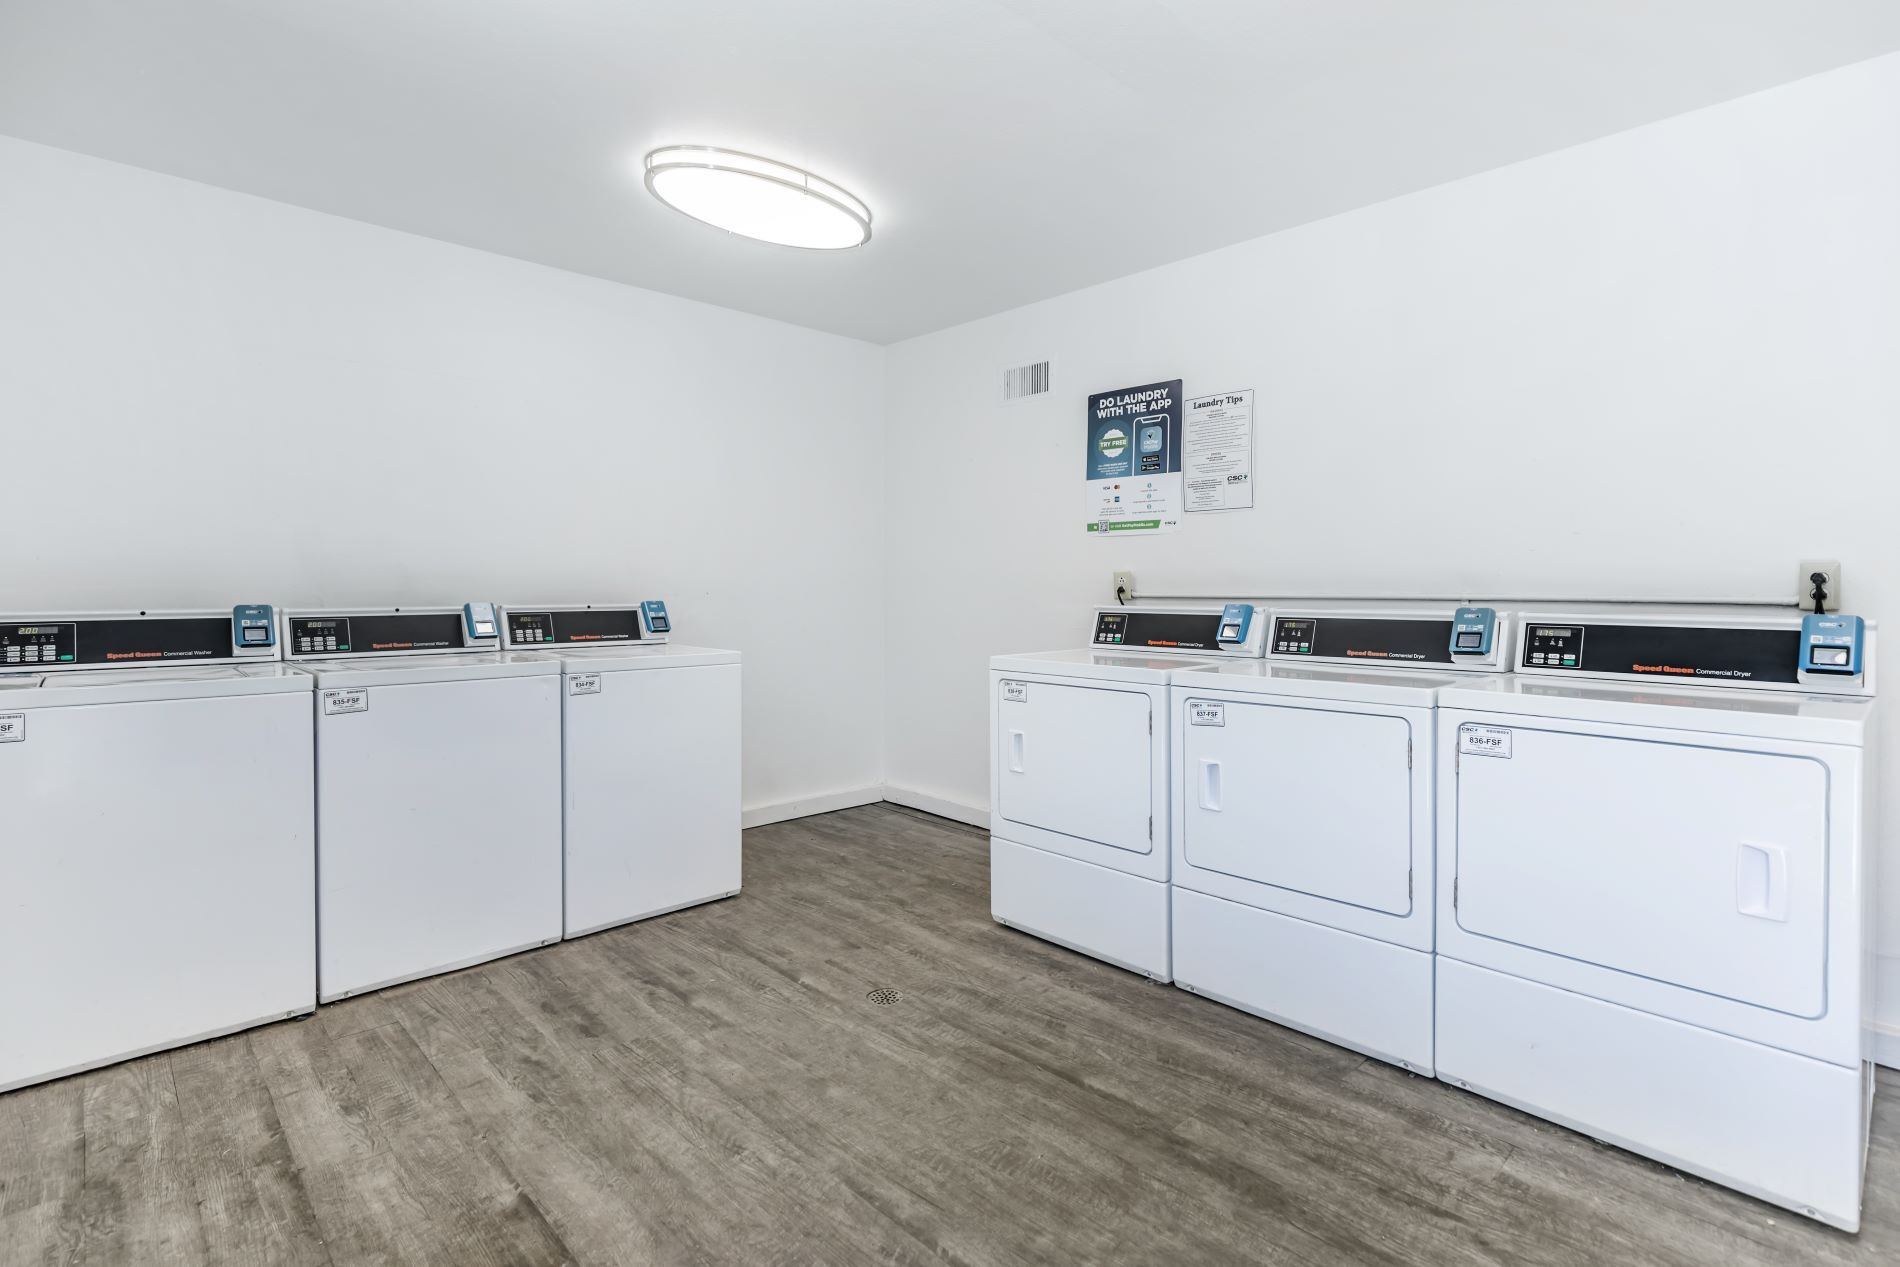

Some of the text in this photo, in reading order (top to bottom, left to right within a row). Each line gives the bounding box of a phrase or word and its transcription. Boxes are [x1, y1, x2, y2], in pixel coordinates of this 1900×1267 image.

[1100, 388, 1169, 409] DO LAUNDRY
[1192, 396, 1244, 410] Laundry Tips
[1097, 399, 1172, 419] WITH THE APP
[1100, 438, 1127, 448] TRY FREE
[1632, 664, 1752, 678] Speed Queen Commercial Dryer
[1469, 736, 1502, 746] 836-FSF
